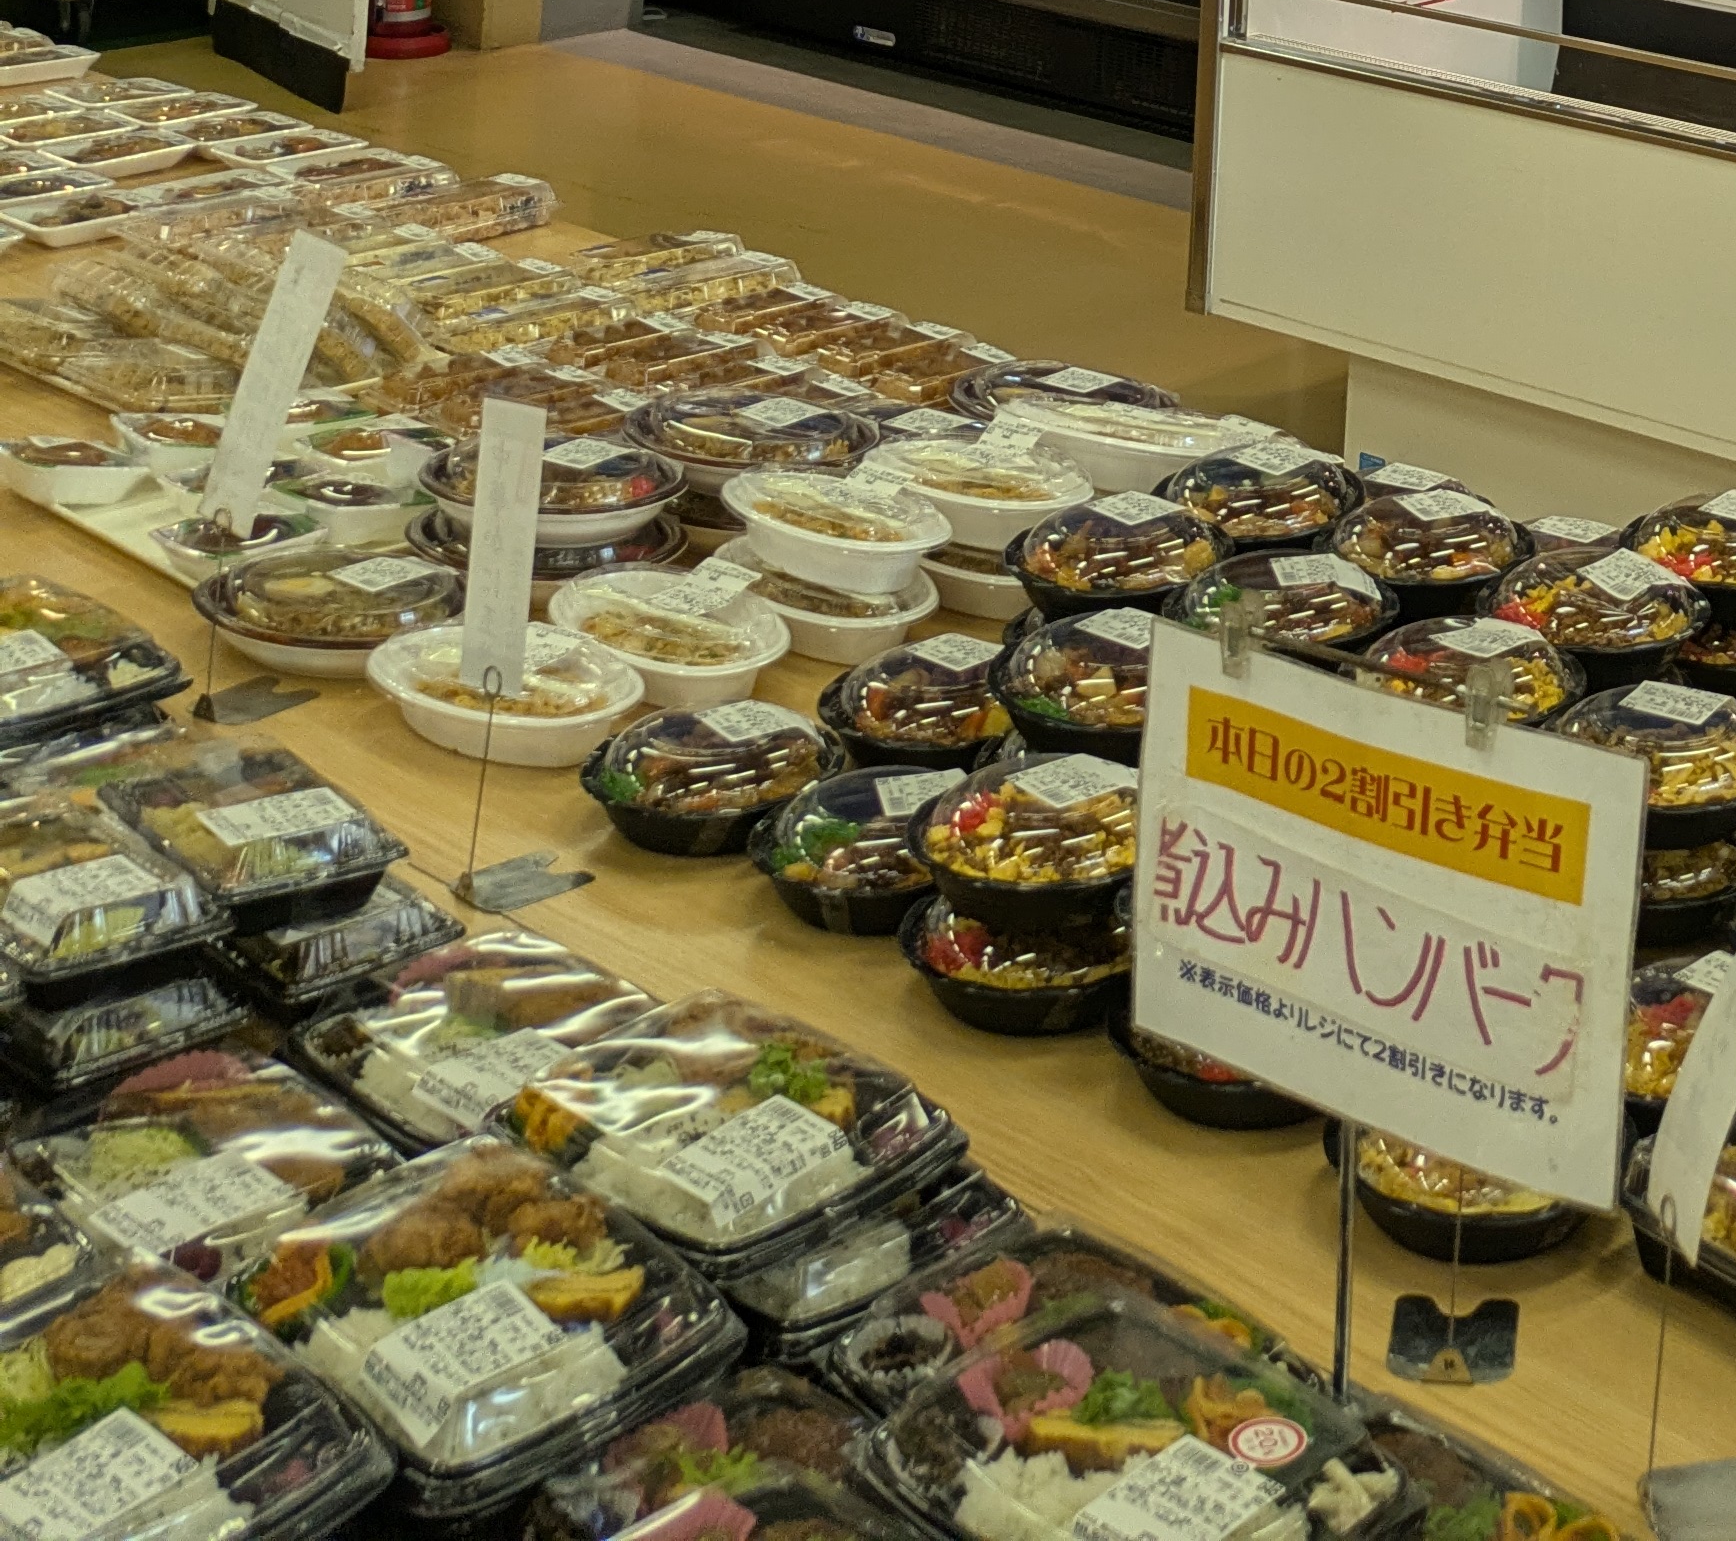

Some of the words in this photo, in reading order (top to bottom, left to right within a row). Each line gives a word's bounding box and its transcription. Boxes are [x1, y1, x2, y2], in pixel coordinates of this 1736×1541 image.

[1206, 716, 1564, 875] 本日の2割引き弁当
